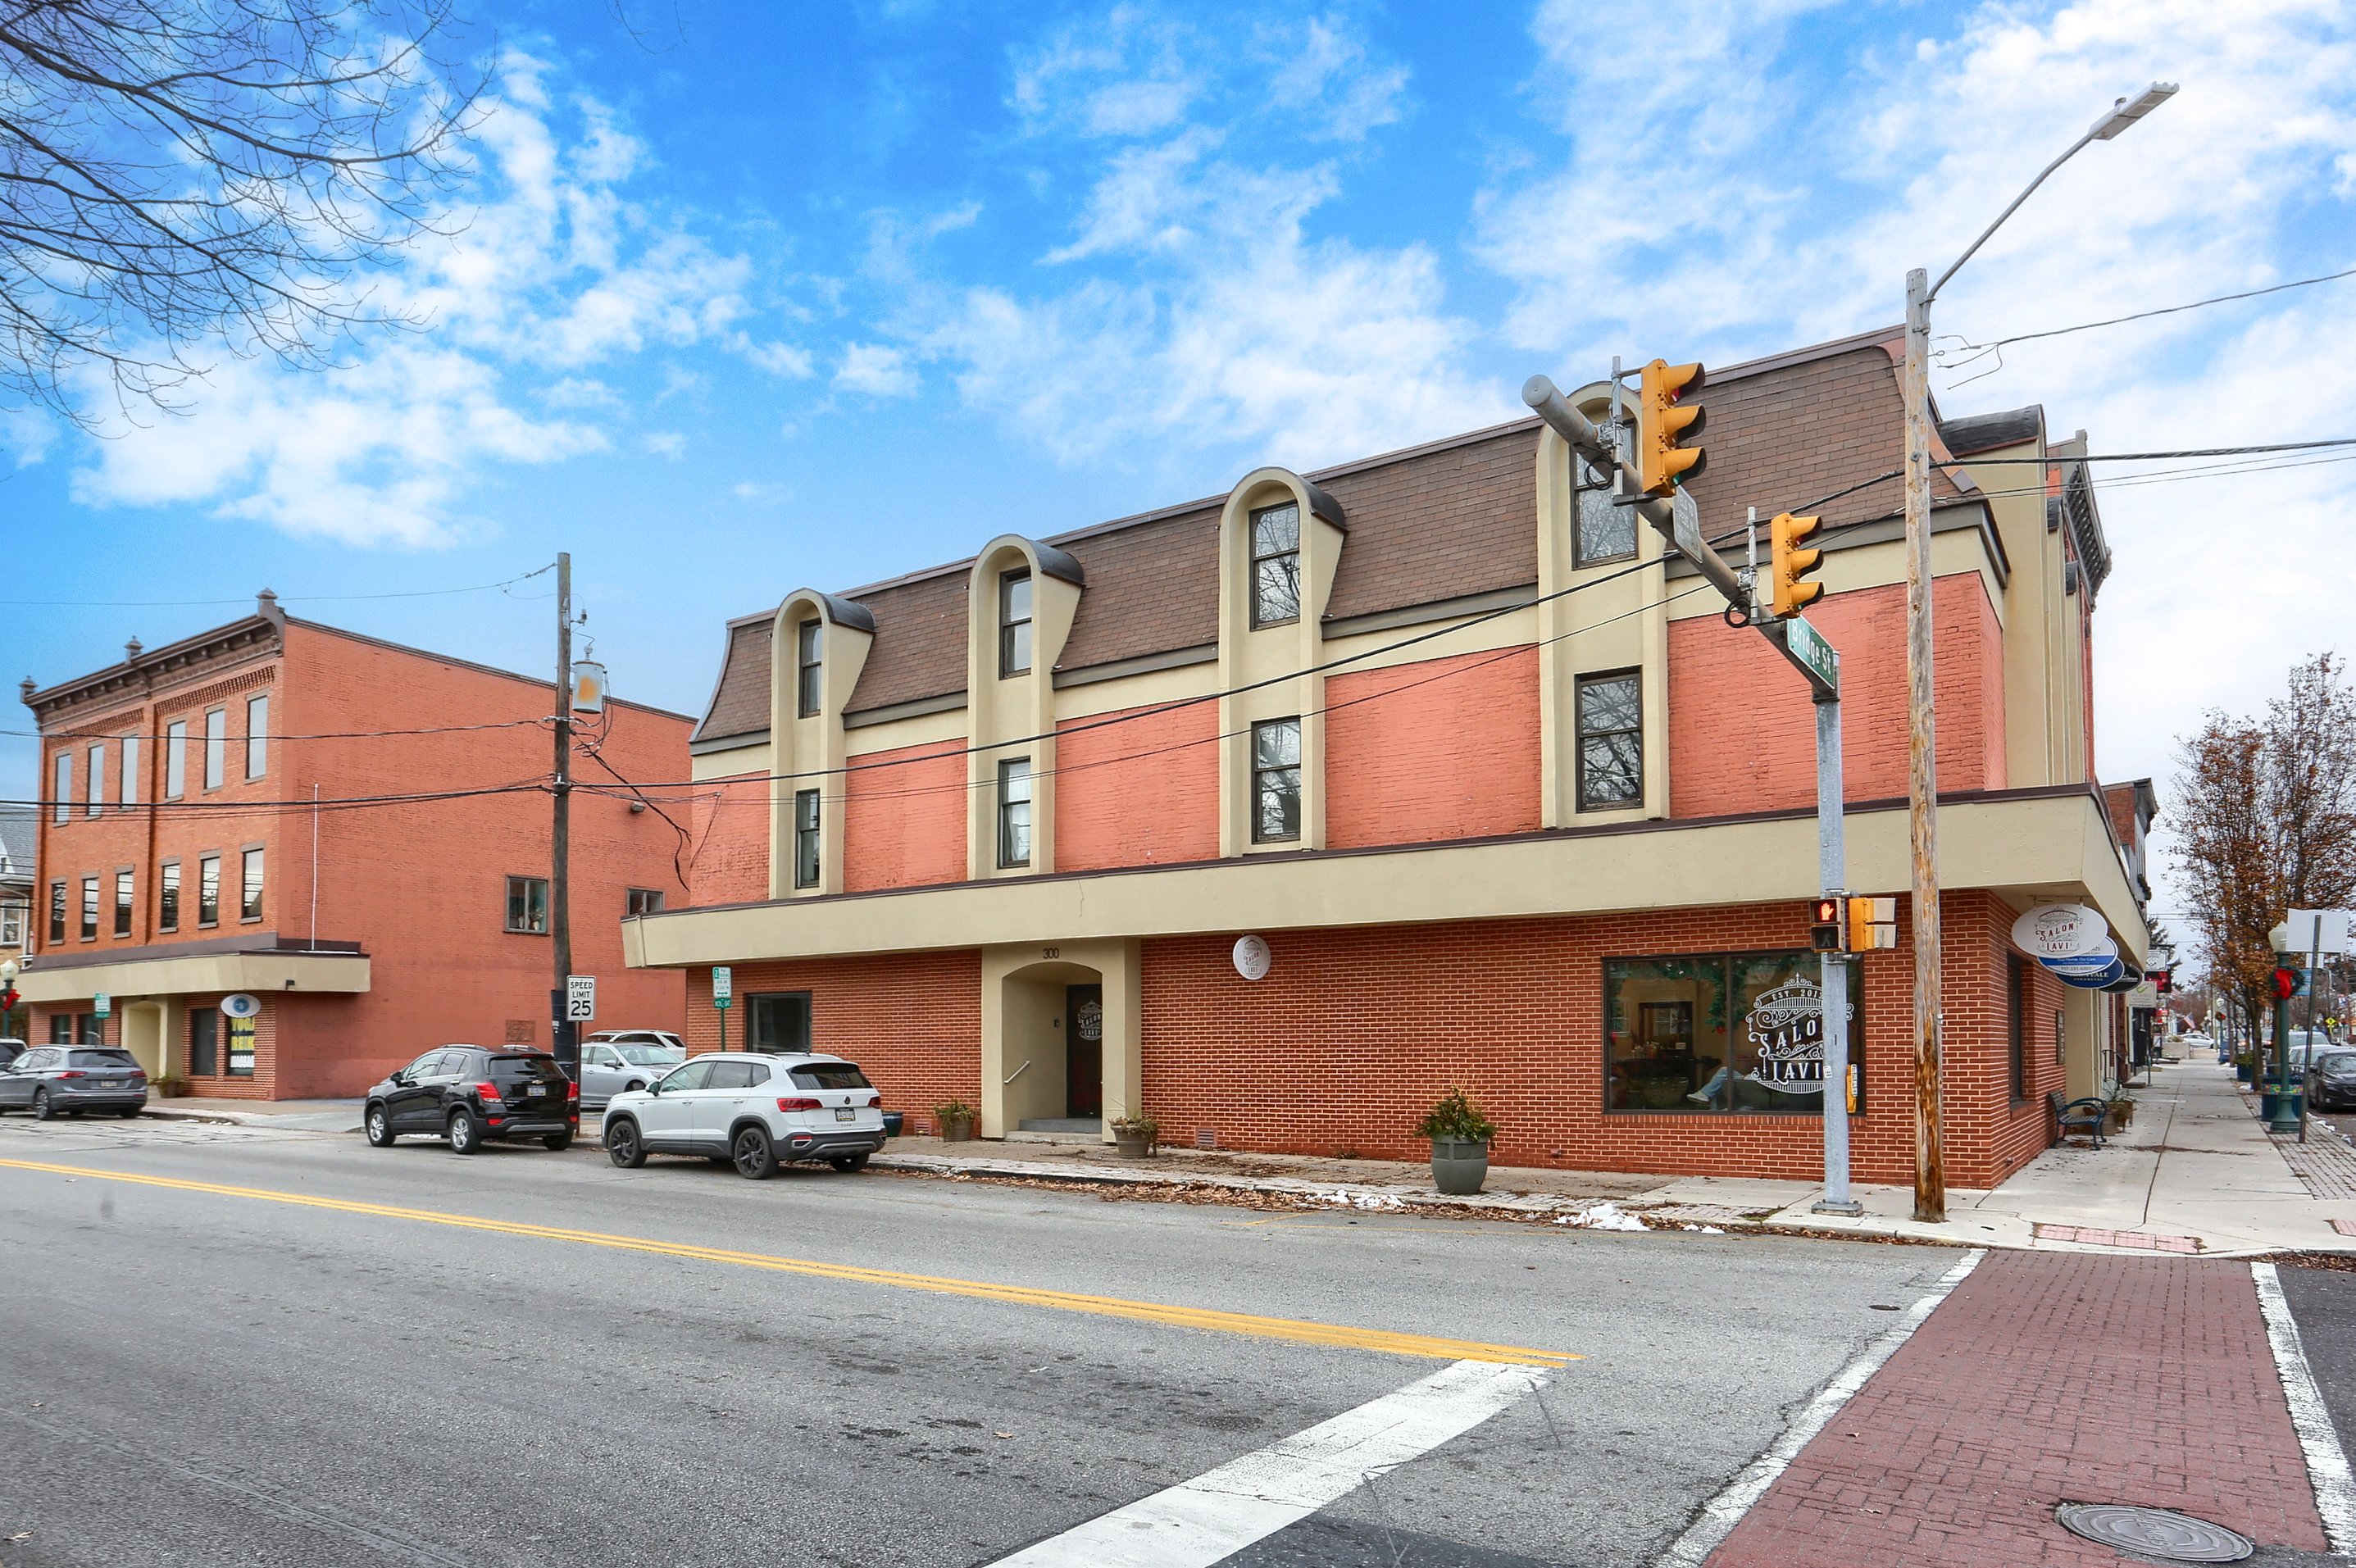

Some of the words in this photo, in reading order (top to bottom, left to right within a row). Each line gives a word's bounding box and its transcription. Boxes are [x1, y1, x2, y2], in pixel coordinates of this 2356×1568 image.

[1792, 620, 1820, 665] Bridge
[1822, 648, 1831, 675] St
[2035, 923, 2073, 941] SALON
[1043, 948, 1060, 959] 300
[2047, 943, 2068, 952] LAVI
[570, 981, 594, 989] SPEED
[1772, 990, 1794, 1000] EST.
[571, 1000, 591, 1016] 25
[1749, 1020, 1822, 1057] SALO
[1772, 1062, 1820, 1085] LAVI
